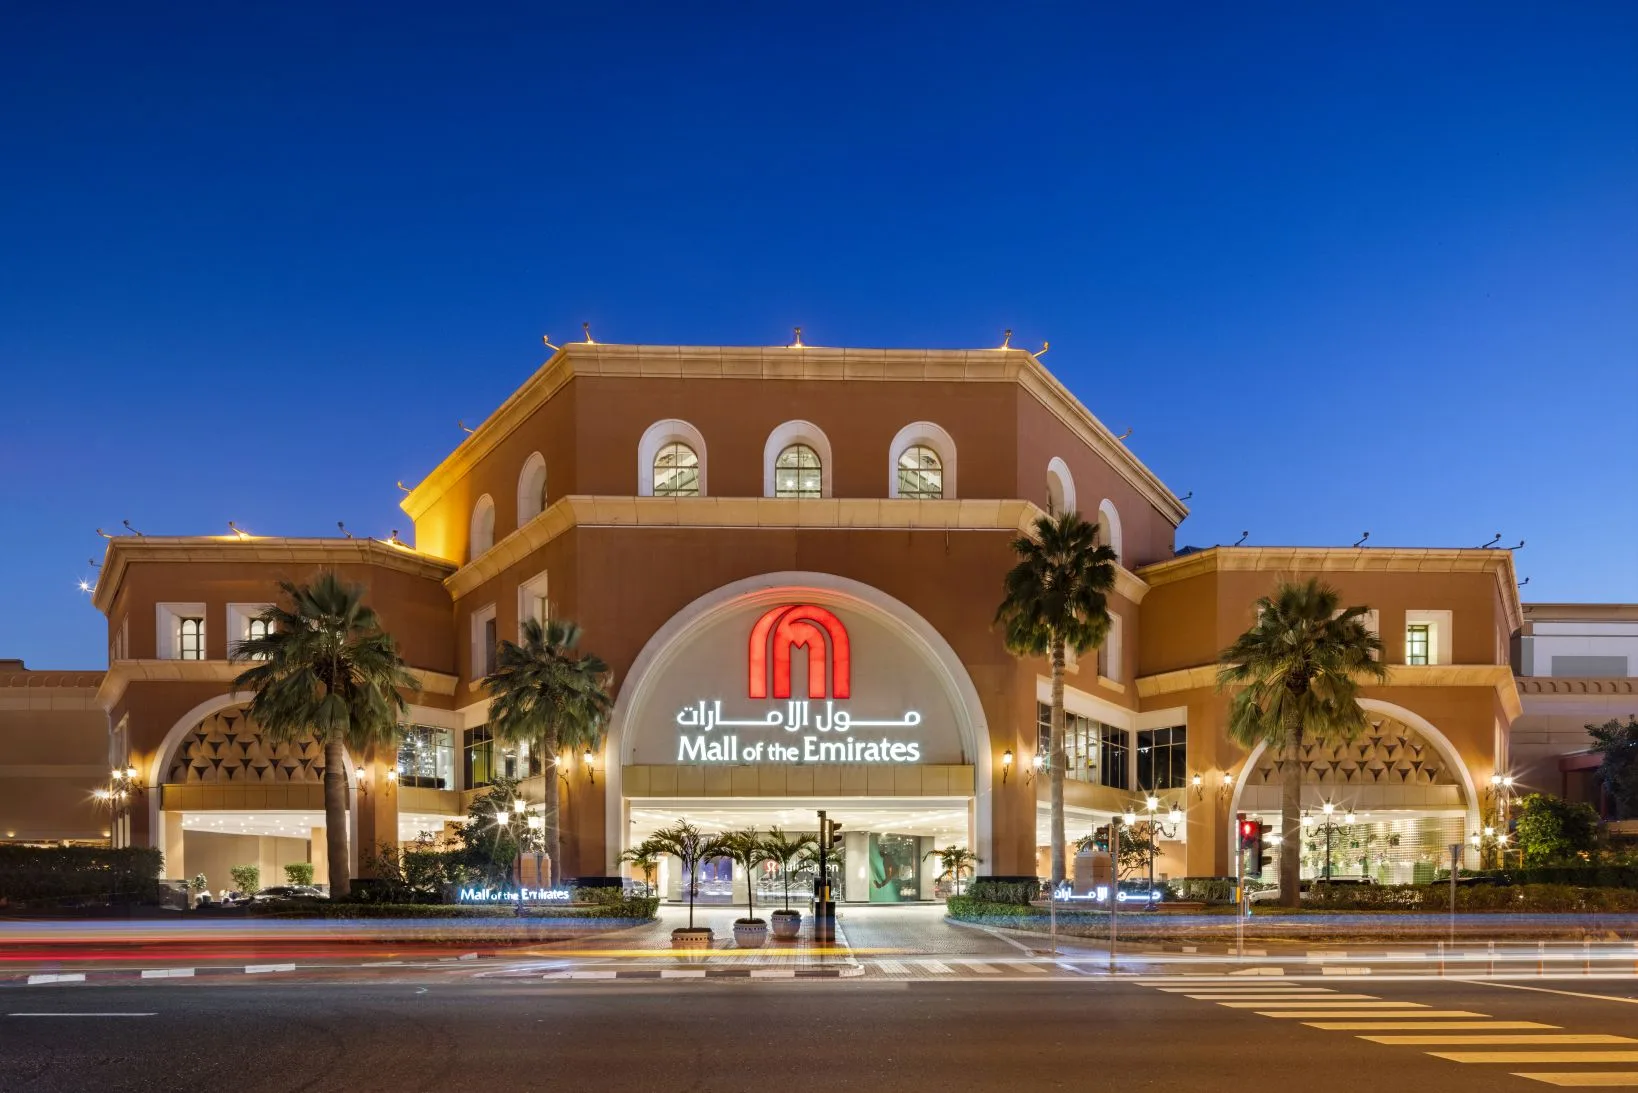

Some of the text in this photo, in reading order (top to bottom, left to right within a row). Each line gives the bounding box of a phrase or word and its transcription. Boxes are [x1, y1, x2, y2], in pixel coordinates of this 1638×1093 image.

[816, 700, 921, 732] مول
[677, 735, 921, 762] Mall of the Emirates
[460, 888, 570, 900] Mall of the Emirates
